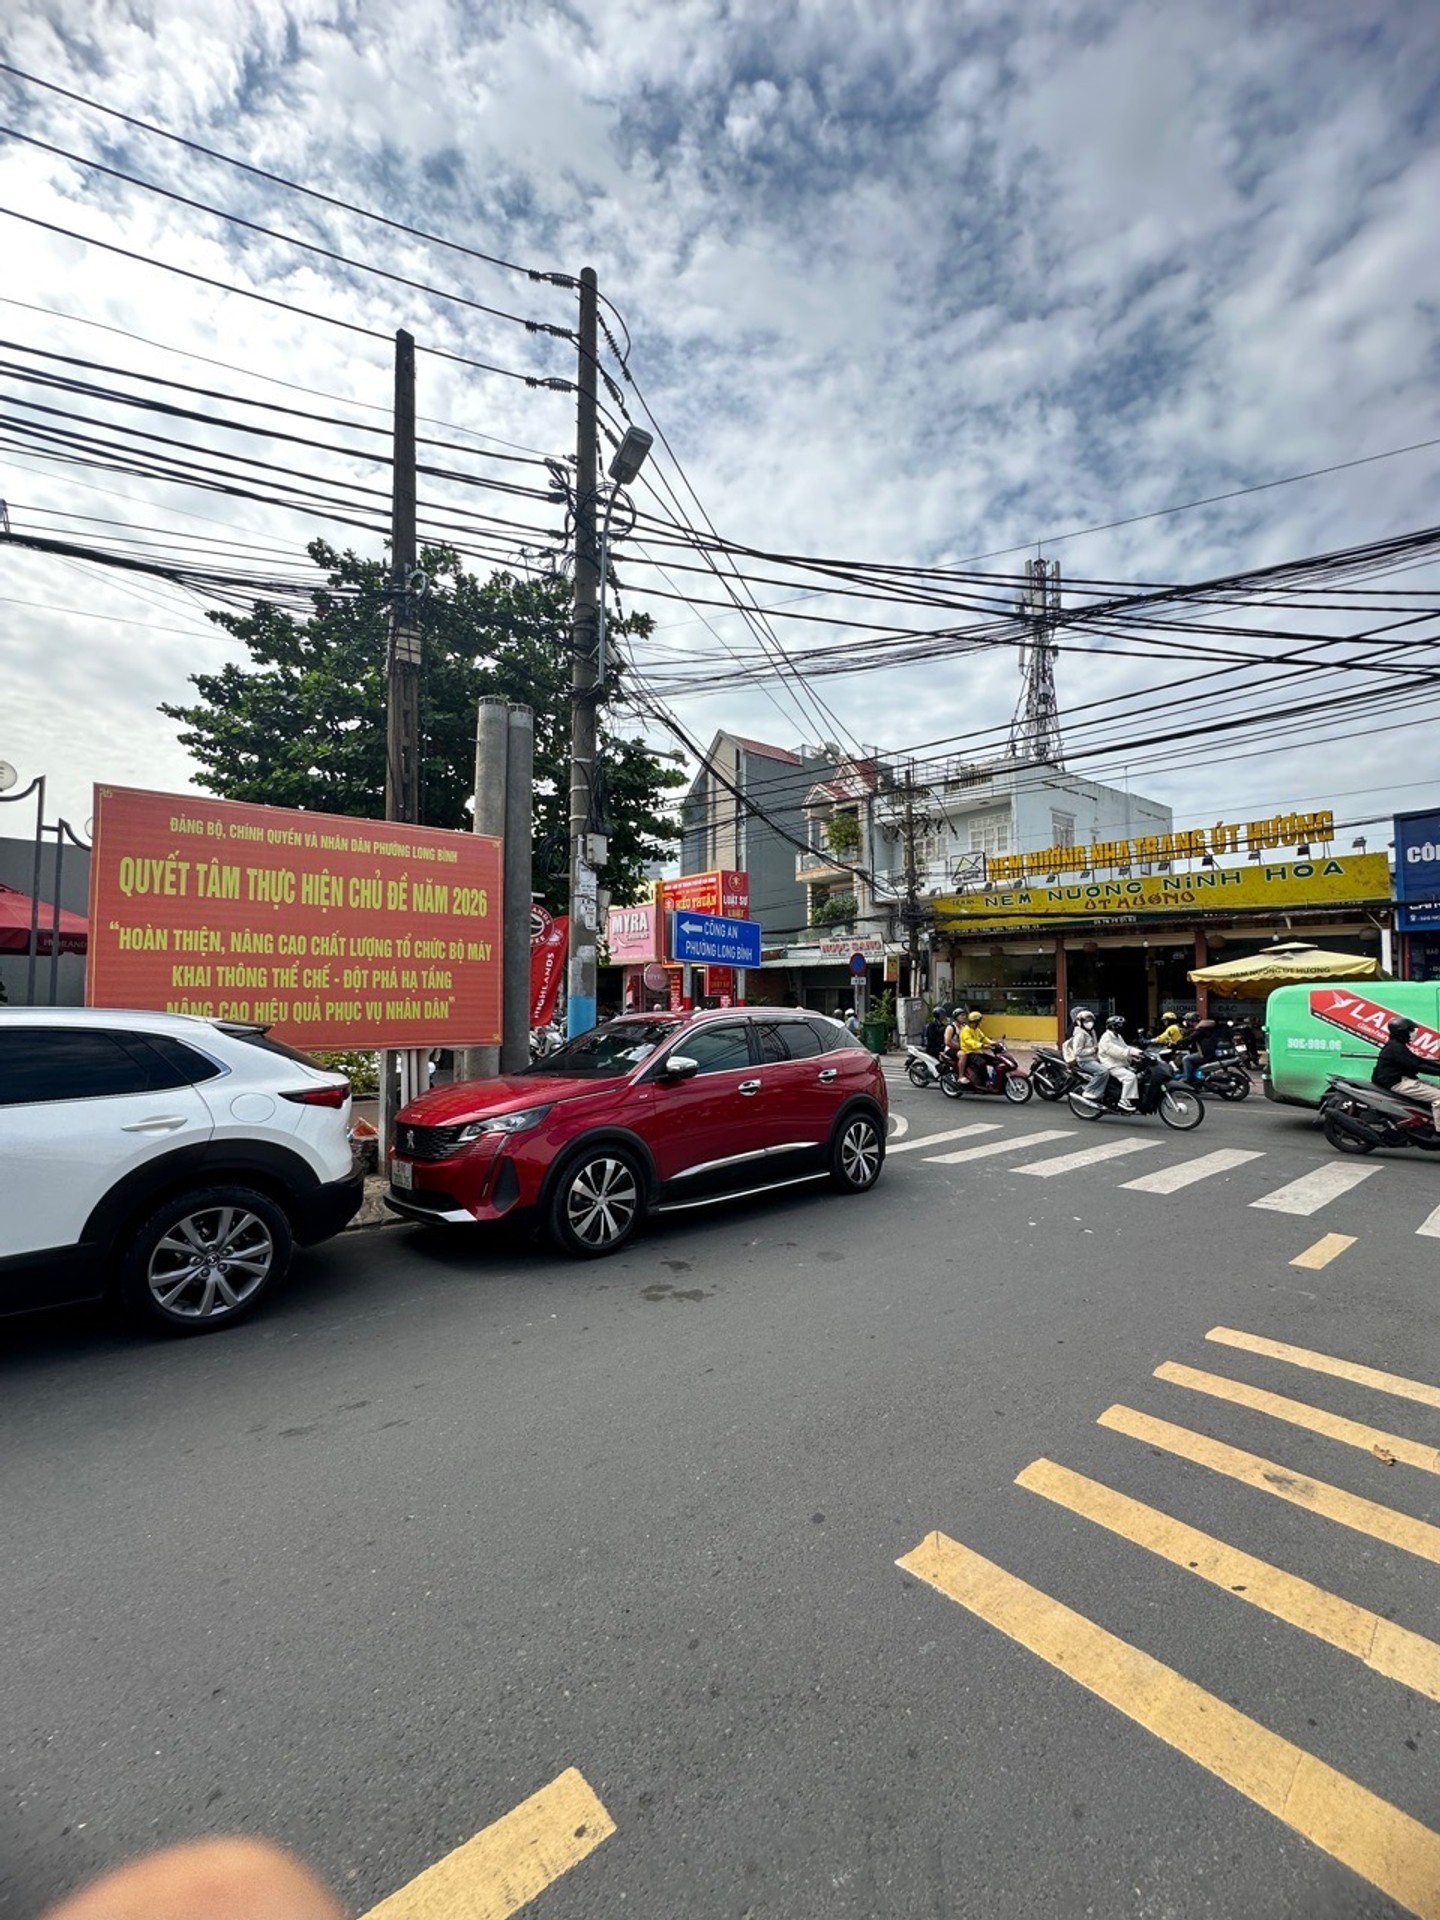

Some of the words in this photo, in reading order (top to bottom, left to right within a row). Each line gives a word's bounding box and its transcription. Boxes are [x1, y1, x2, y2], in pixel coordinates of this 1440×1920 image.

[170, 813, 204, 835] ĐẢNG
[207, 819, 226, 839] BỘ,
[230, 822, 264, 842] CHÍNH
[305, 831, 318, 848] VÀ
[321, 834, 349, 851] NHÂN
[351, 836, 371, 853] DÂN
[373, 841, 411, 858] PHƯỜNG
[412, 846, 435, 860] LONG
[437, 846, 458, 863] BÌNH
[987, 855, 1023, 881] NEM
[1133, 829, 1206, 863] TRANG
[1211, 821, 1240, 854] ÚT
[1247, 810, 1334, 850] HƯƠNG
[119, 850, 190, 897] QUYẾT
[196, 857, 240, 900] TÂM
[246, 868, 296, 911] THỰC
[301, 868, 343, 913] HIỆN
[349, 869, 383, 910] CHỦ
[387, 872, 408, 911] ĐỀ
[412, 878, 448, 914] NĂM
[452, 887, 487, 917] 2026
[985, 893, 1031, 907] NEM
[612, 911, 648, 934] MYRA
[704, 920, 726, 937] CÔNG
[727, 925, 739, 939] AN
[109, 920, 168, 950] “HOÀN
[173, 926, 226, 957] THIỆN,
[231, 928, 274, 954] NÂNG
[278, 934, 307, 955] CAO
[311, 929, 346, 956] CHẤT
[350, 936, 393, 961] LƯỢNG
[395, 933, 411, 958] TỔ
[414, 937, 446, 960] CHỨC
[449, 938, 465, 964] BỘ
[468, 940, 492, 961] MÁY
[685, 939, 716, 957] PHƯỜNG
[717, 943, 736, 959] LONG
[737, 944, 753, 961] BÌNH
[172, 965, 211, 987] KHAI
[216, 962, 268, 988] THÔNG
[272, 960, 298, 988] THỂ
[303, 962, 331, 989] CHẾ
[343, 965, 369, 993] ĐỘT
[372, 965, 398, 989] PHÁ
[401, 969, 418, 993] HẠ
[534, 952, 555, 1019] HIGHLANDS
[218, 1000, 249, 1021] CAO
[293, 995, 322, 1025] QUẢ
[325, 1001, 362, 1025] PHỤC
[365, 1001, 382, 1025] VỤ
[386, 997, 421, 1020] NHÂN
